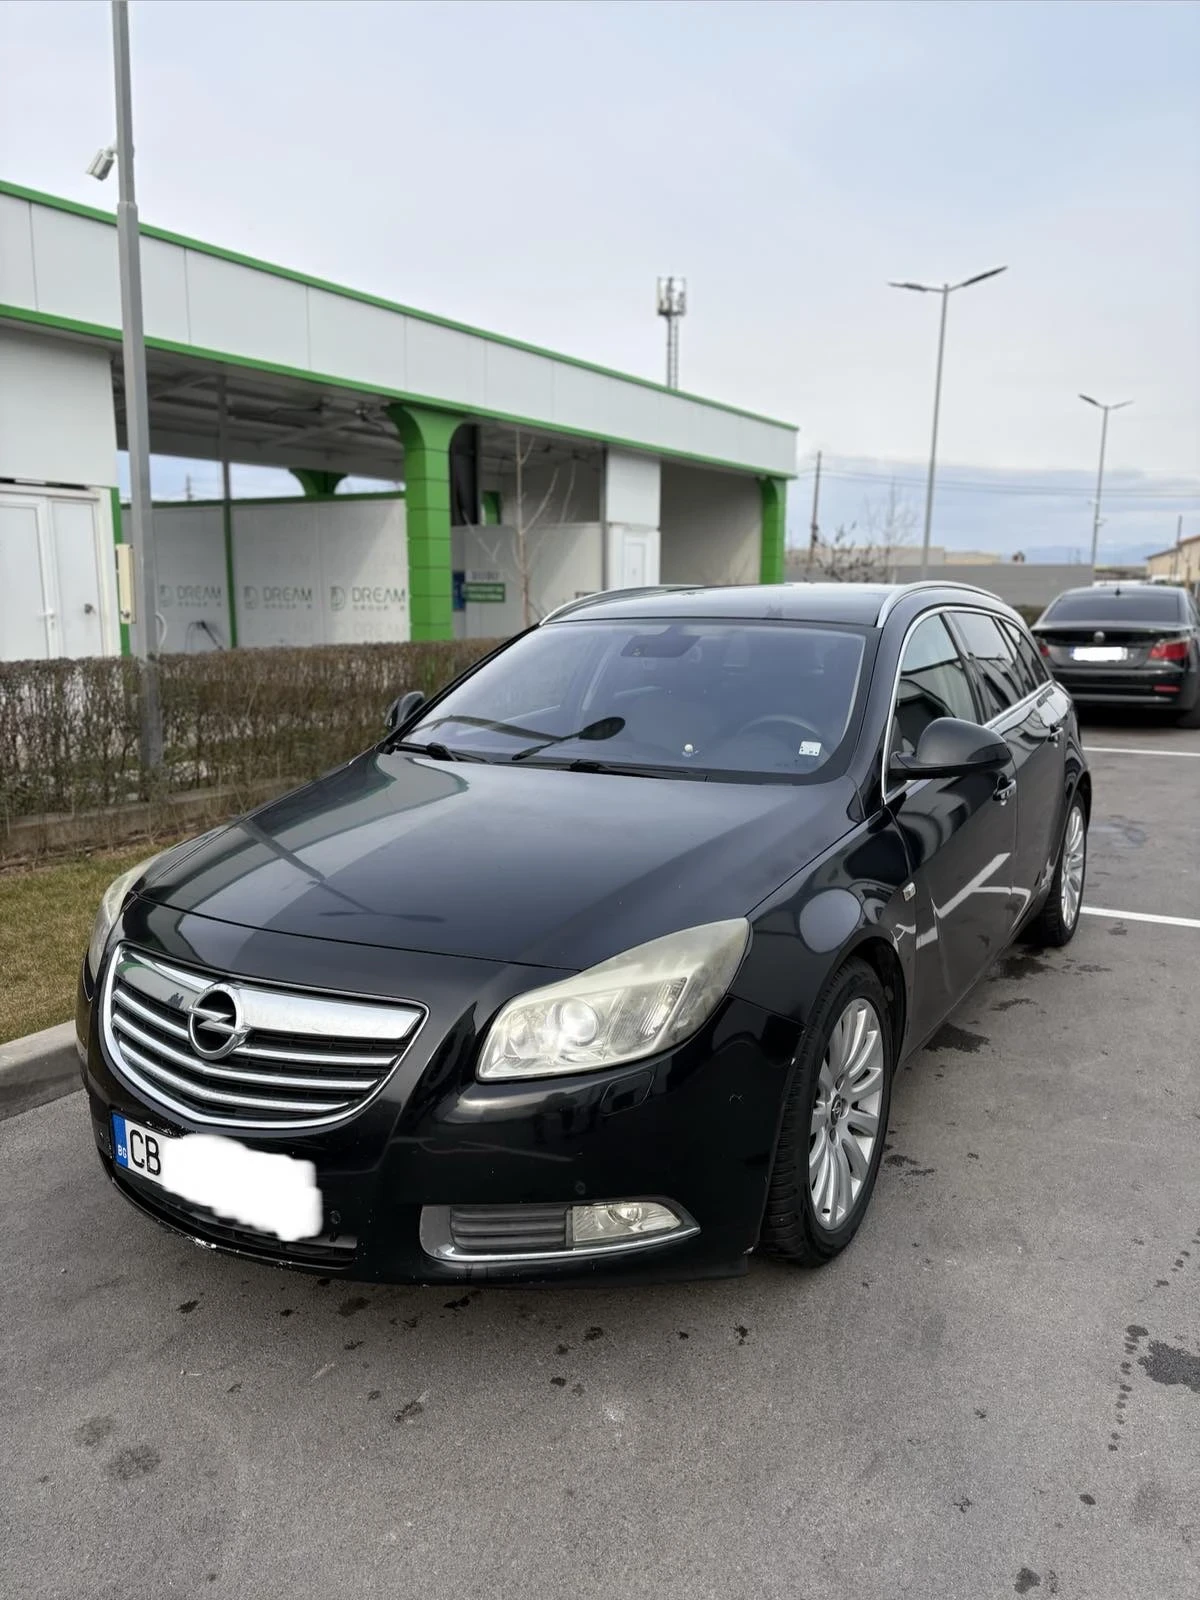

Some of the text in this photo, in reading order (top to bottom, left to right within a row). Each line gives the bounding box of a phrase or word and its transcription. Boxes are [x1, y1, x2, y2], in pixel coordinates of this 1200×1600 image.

[177, 585, 222, 600] DREAM
[263, 586, 312, 601] DREAM
[352, 587, 406, 603] DREAM
[118, 1144, 127, 1159] BG
[129, 1129, 161, 1176] CB
